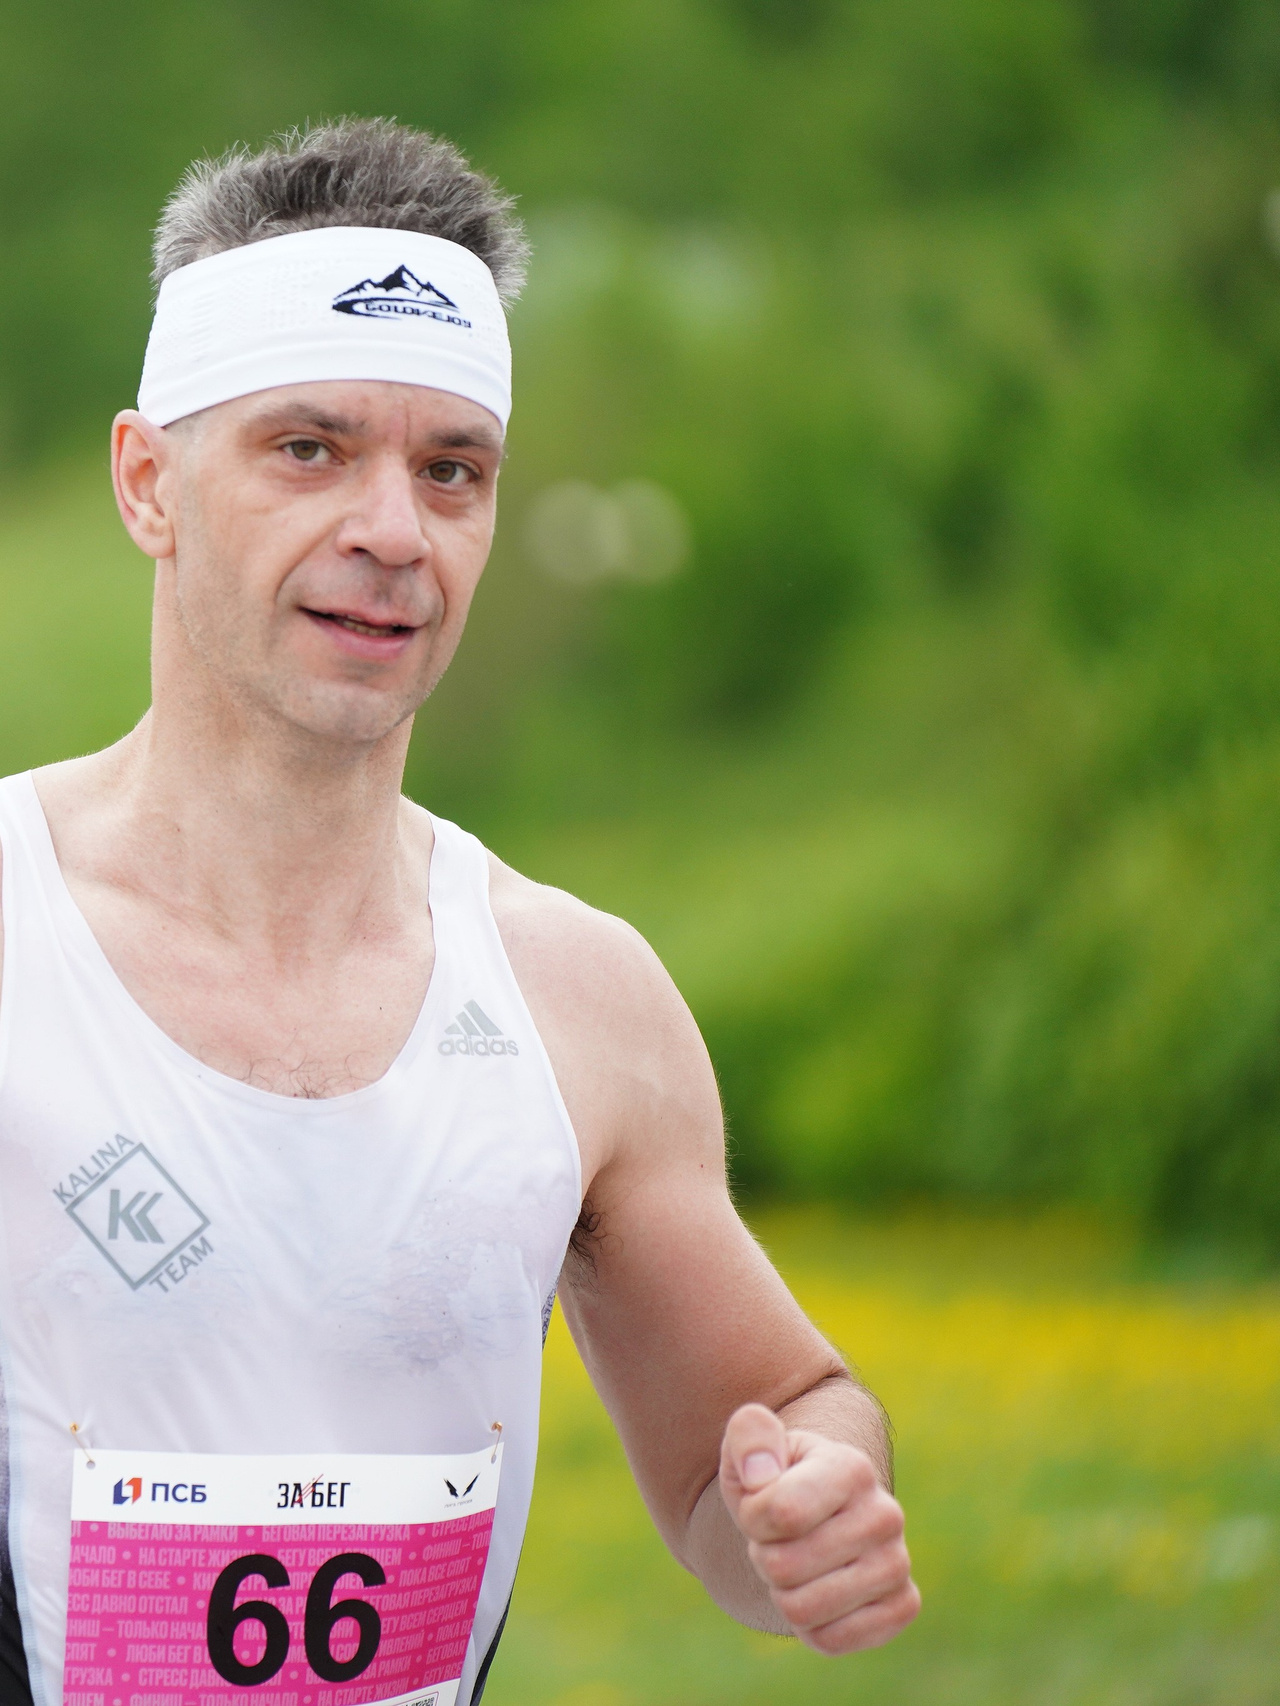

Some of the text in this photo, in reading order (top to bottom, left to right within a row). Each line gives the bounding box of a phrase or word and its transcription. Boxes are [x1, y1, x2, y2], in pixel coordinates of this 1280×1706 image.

[437, 1033, 519, 1056] adidas
[53, 1133, 135, 1205] KALINA
[149, 1236, 215, 1293] TEAM
[151, 1483, 207, 1503] ПСБ
[107, 1522, 238, 1543] ВЫБЕГАЮ ЗА РАМКИ
[262, 1524, 410, 1542] БЕГОВАЯ ПЕРЕЗАГРУЗКА
[139, 1547, 157, 1566] НА
[158, 1548, 206, 1567] СТАРТЕ
[101, 1569, 126, 1588] БЕГ
[127, 1570, 136, 1589] В
[139, 1570, 171, 1590] СЕБЕ
[399, 1567, 427, 1588] ПОКА
[91, 1594, 136, 1615] ДАВНО
[139, 1595, 189, 1615] ОТСТАЛ
[117, 1620, 168, 1640] ТОЛЬКО
[207, 1552, 387, 1687] 66
[381, 1616, 399, 1635] ЕГУ
[126, 1644, 166, 1663] ЛЮБИ
[167, 1645, 191, 1664] БЕГ
[139, 1668, 188, 1687] СТРЕСС
